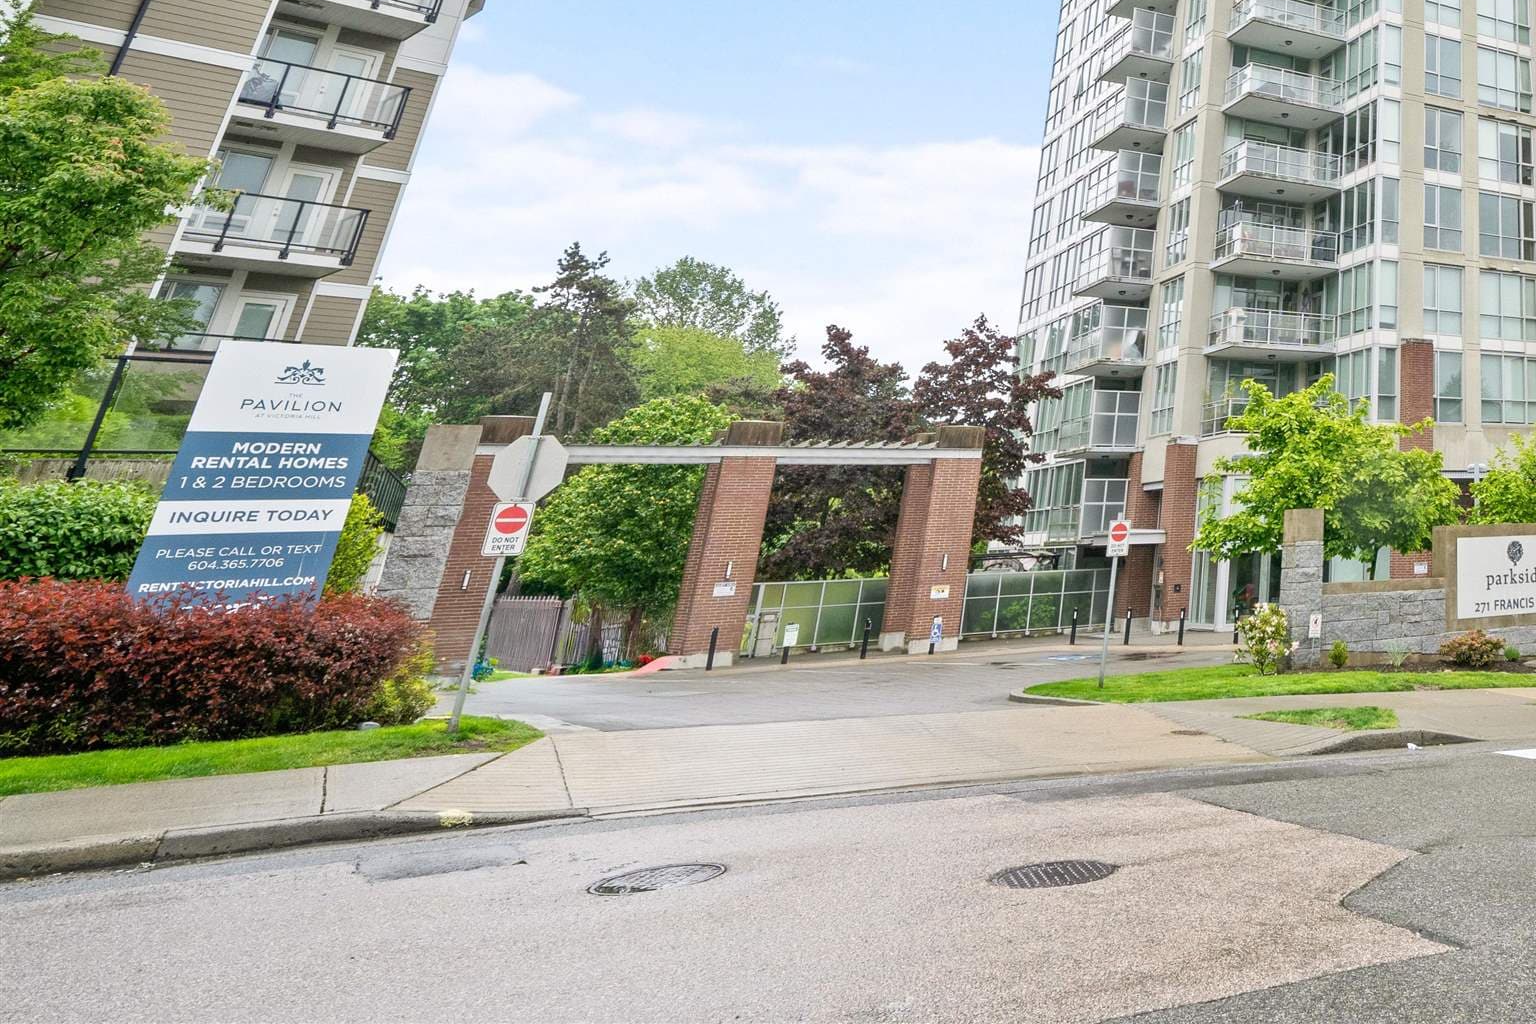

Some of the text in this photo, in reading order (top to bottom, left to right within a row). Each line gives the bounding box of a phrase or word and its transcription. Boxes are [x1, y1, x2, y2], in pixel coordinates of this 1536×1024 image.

[240, 399, 343, 412] PAVILION
[232, 442, 322, 455] MODERN
[191, 457, 348, 469] RENTAL HOMES
[180, 475, 346, 489] 1 & 2 BEDROOMS
[169, 509, 333, 524] INQUIRE TODAY
[155, 544, 322, 559] PLEASE CALL OR TEXT
[187, 558, 284, 571] 604.365.7706
[1474, 602, 1490, 613] 271
[1494, 597, 1535, 611] FRANCIS
